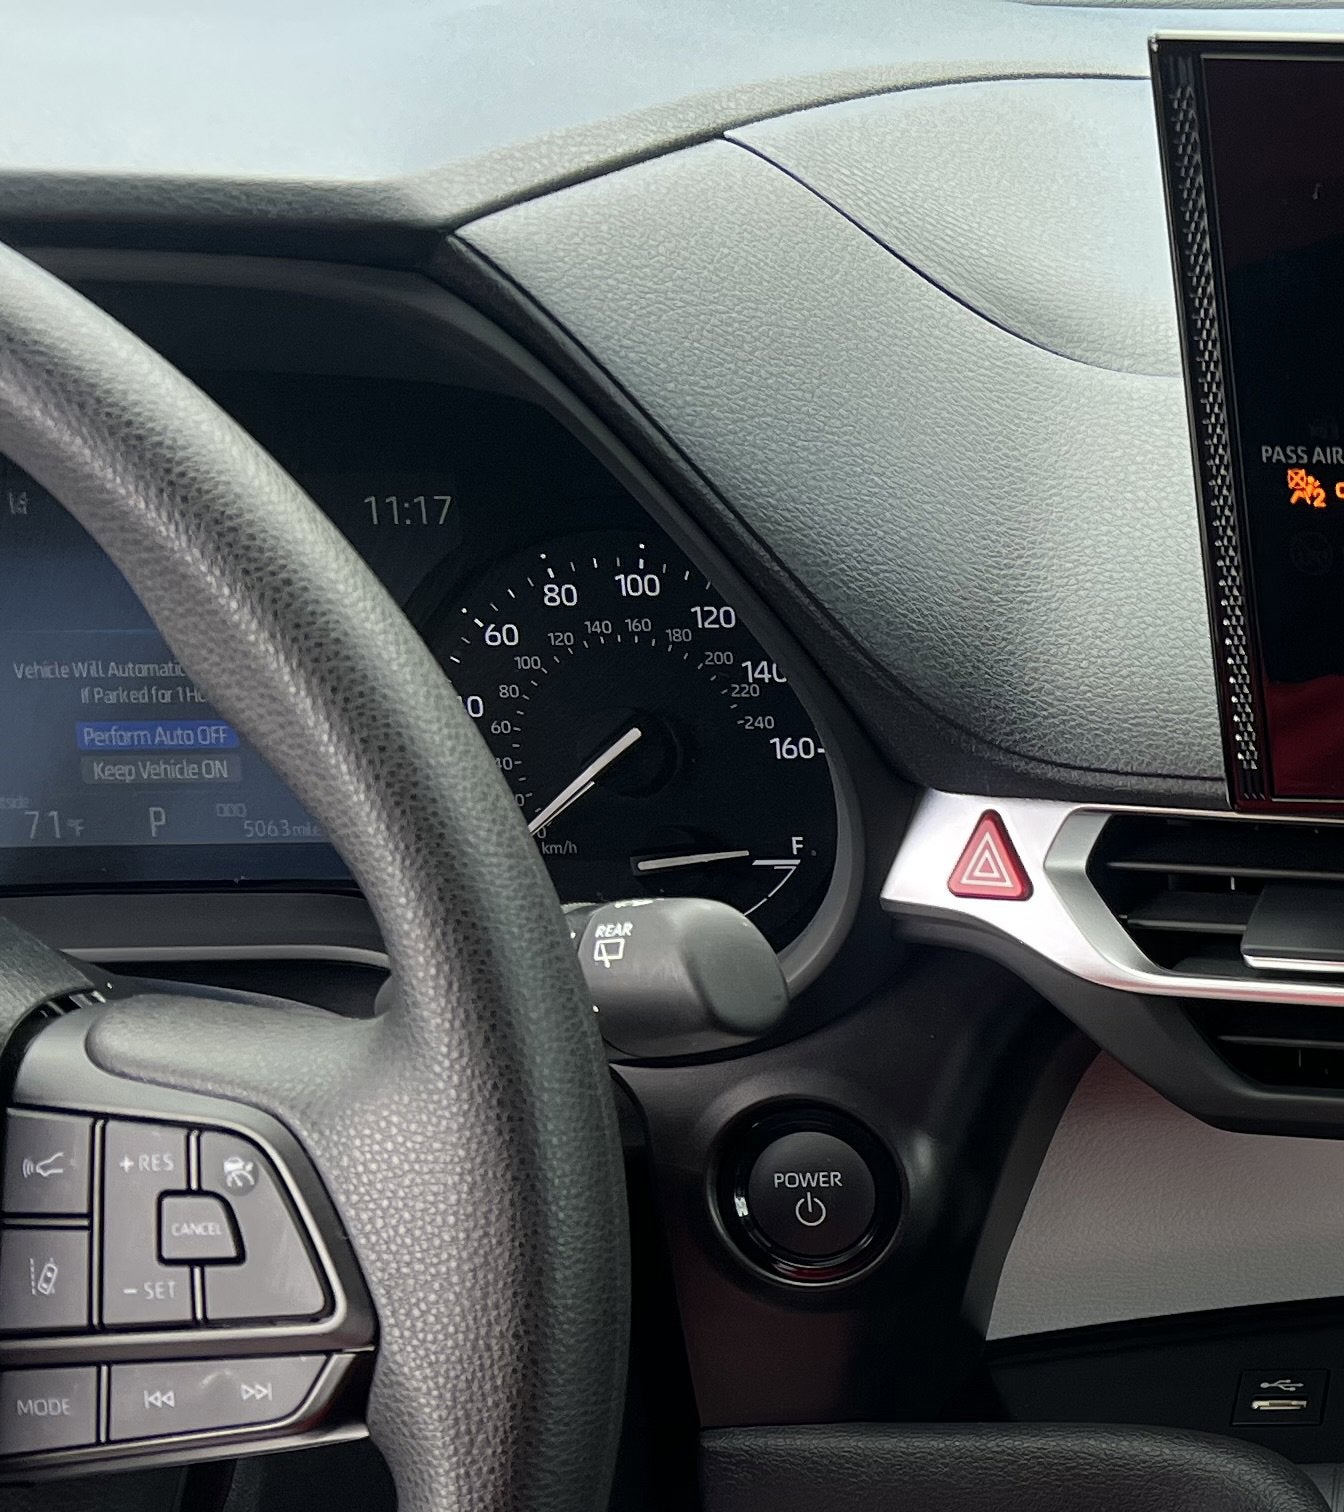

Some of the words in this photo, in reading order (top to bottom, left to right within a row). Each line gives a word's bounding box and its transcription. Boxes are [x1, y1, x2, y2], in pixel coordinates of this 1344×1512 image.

[1261, 445, 1308, 464] PASS
[1312, 446, 1344, 464] AIR
[364, 495, 452, 526] 11:17
[615, 574, 659, 597] 100
[543, 584, 577, 606] 80
[625, 618, 651, 632] 160
[691, 606, 736, 628] 120
[485, 624, 519, 646] 60
[585, 620, 611, 634] 140
[666, 629, 692, 642] 180
[548, 632, 574, 646] 120
[514, 656, 541, 670] 100
[705, 652, 733, 665] 200
[13, 662, 69, 679] Vehicle
[72, 662, 105, 678] Will
[95, 687, 148, 703] Parked
[151, 687, 174, 702] for
[499, 684, 519, 699] 80
[731, 684, 760, 698] 220
[491, 721, 511, 735] 60
[744, 715, 774, 729] 240
[84, 727, 150, 747] Perform
[155, 728, 193, 745] Auto
[197, 726, 227, 744] OFF
[770, 737, 814, 759] 160
[94, 762, 135, 782] Keep
[137, 761, 198, 779] Vehicle
[202, 761, 228, 778] ON
[149, 807, 166, 837] P
[244, 819, 290, 837] 5063
[542, 841, 577, 855] km/h
[792, 837, 803, 854] F
[595, 923, 633, 938] REAR
[774, 1171, 842, 1188] POWER
[172, 1223, 222, 1236] CANCEL
[17, 1398, 70, 1415] MODE
